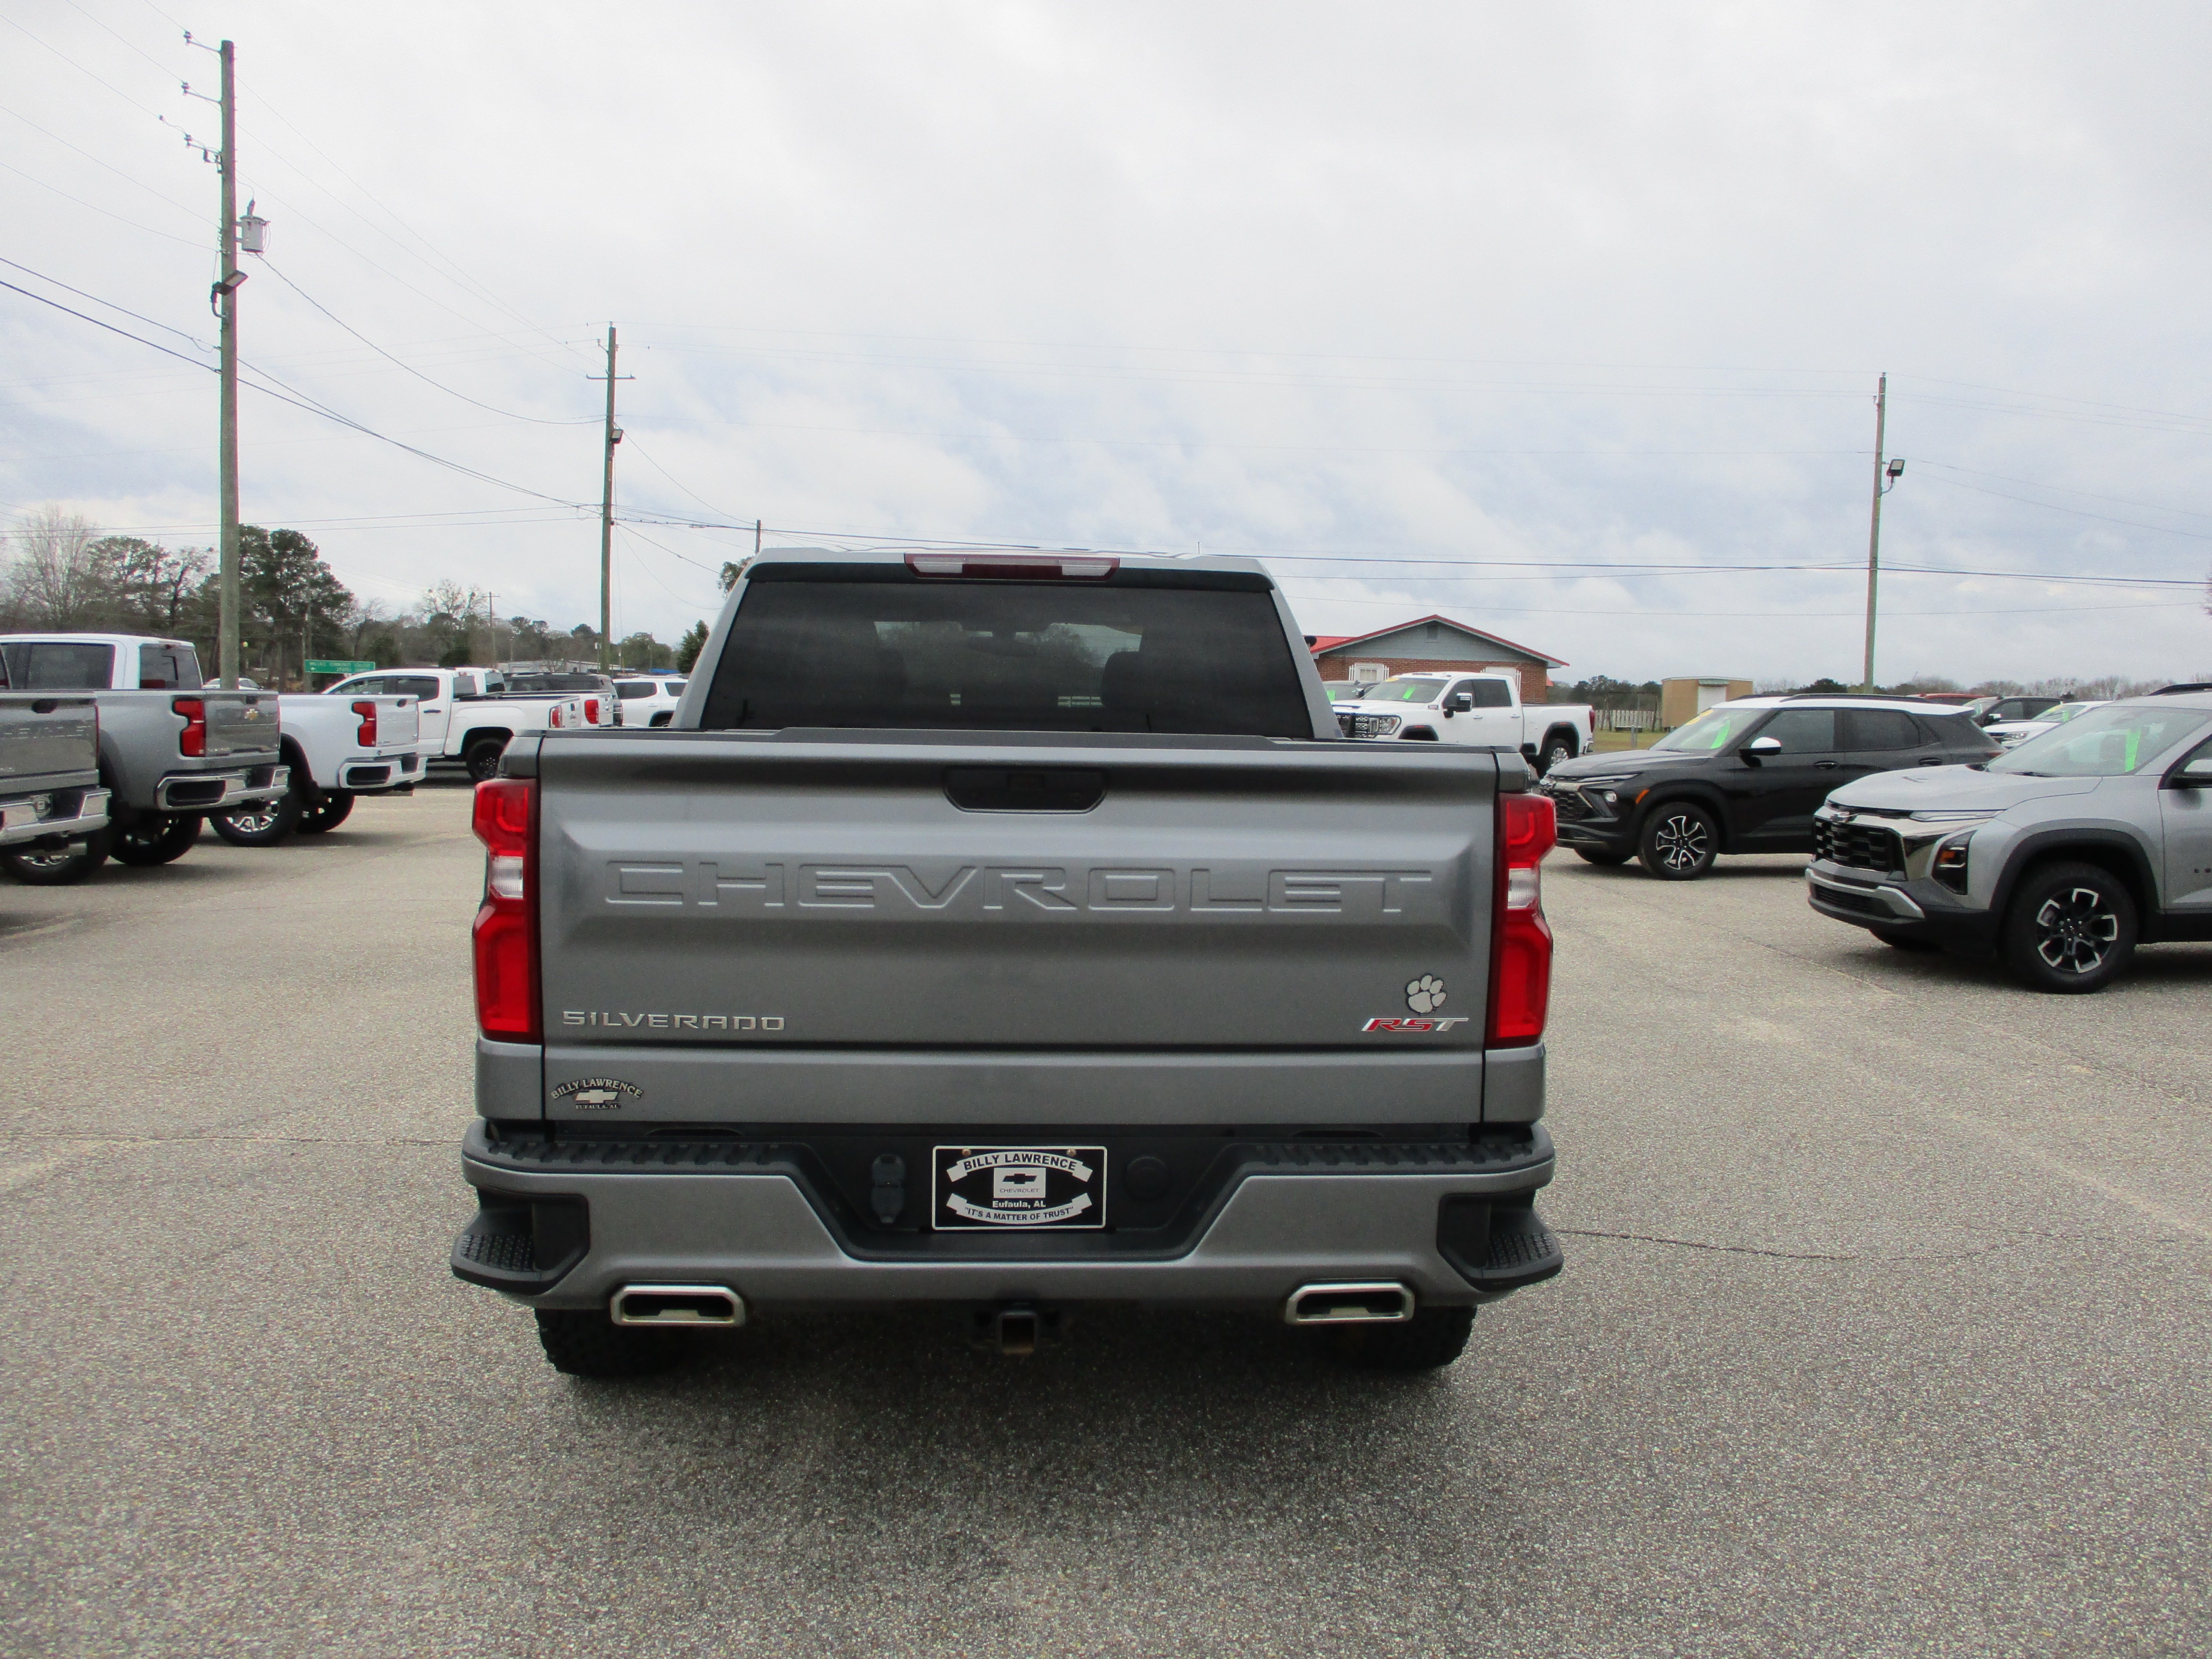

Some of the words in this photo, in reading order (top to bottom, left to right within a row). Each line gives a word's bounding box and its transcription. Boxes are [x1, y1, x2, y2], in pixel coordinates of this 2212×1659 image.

[605, 860, 1431, 913] CHEVROLET
[562, 1010, 785, 1031] SILVERADO
[1361, 1018, 1469, 1032] RST
[551, 1081, 579, 1099] BILLY
[583, 1079, 643, 1098] LAWRENCE
[963, 1155, 1000, 1171] BILLY
[1005, 1154, 1077, 1171] LAWRENCE
[993, 1200, 1030, 1209] Eufaula,
[1043, 1206, 1074, 1218] TRUST"
